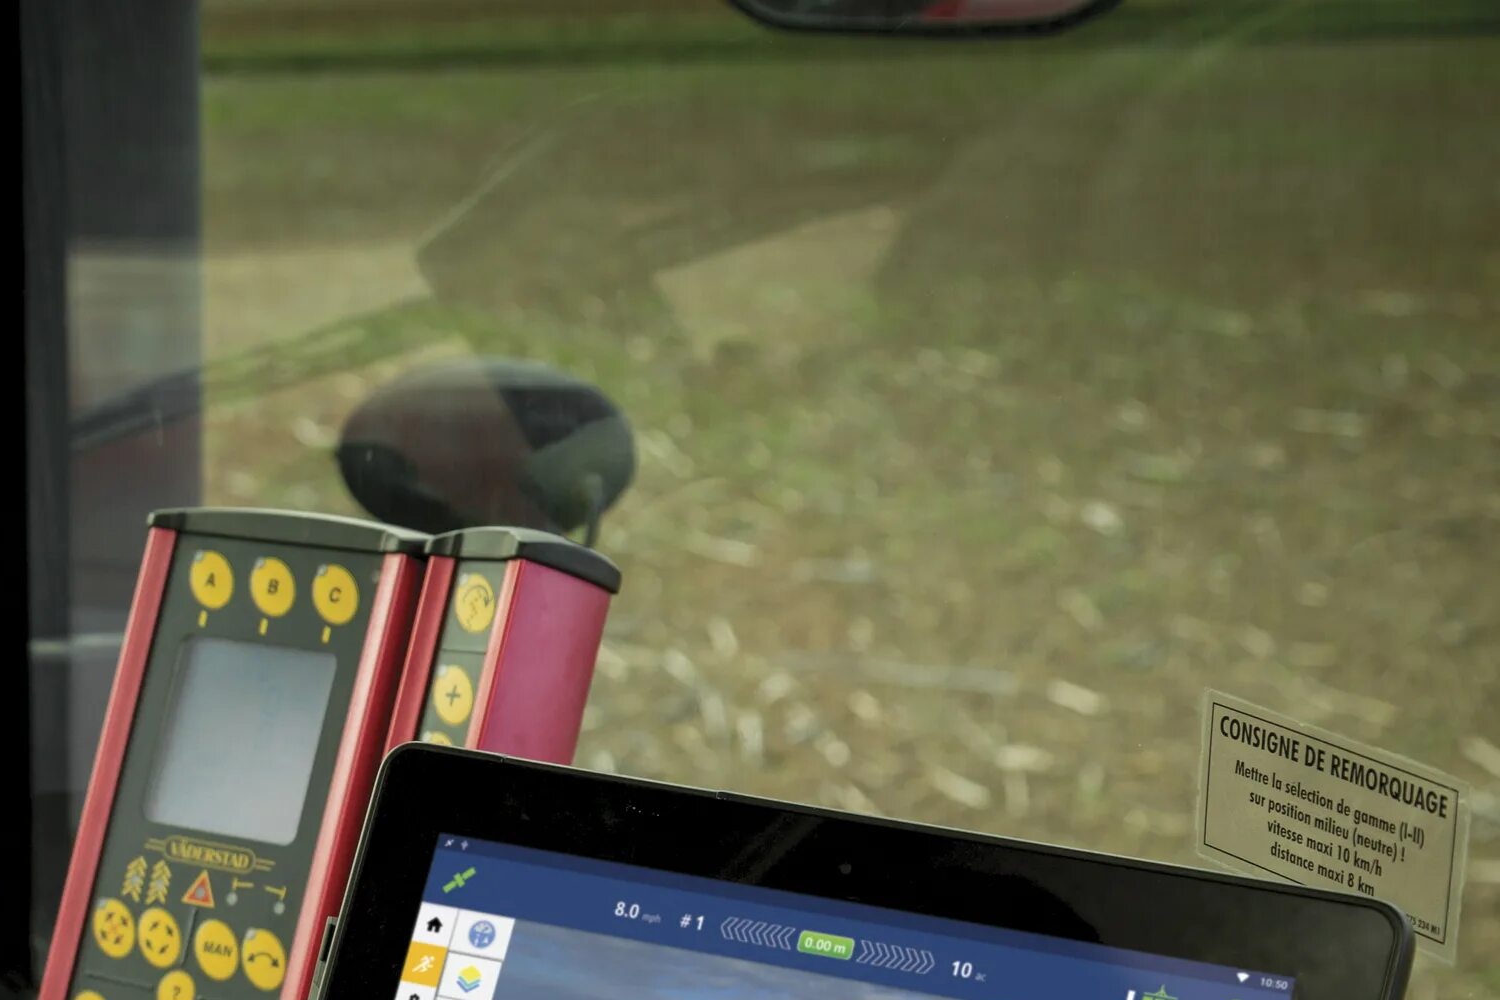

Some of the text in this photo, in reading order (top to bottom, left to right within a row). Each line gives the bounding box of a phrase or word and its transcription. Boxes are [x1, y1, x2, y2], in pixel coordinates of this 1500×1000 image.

[205, 573, 216, 588] A
[268, 579, 280, 595] B
[329, 587, 342, 603] C
[1220, 715, 1449, 819] CONSIGNE DE REMORQUAGE
[1235, 759, 1269, 785] Mettre
[1272, 772, 1282, 790] la
[1337, 798, 1351, 816] de
[1353, 809, 1396, 834] gamme
[1249, 791, 1266, 807] sur
[1268, 799, 1311, 825] position
[1314, 816, 1349, 840] milieu
[1352, 827, 1397, 863] (neutre)
[1267, 820, 1383, 877] vitesse maxi 10 km/h
[1270, 841, 1375, 897] distance maxi 8 km
[614, 901, 640, 919] 8.0
[696, 915, 704, 931] 1
[203, 941, 233, 957] MAN
[804, 936, 846, 954] 0.00 m
[952, 960, 973, 978] 10
[1260, 977, 1289, 990] 10:50
